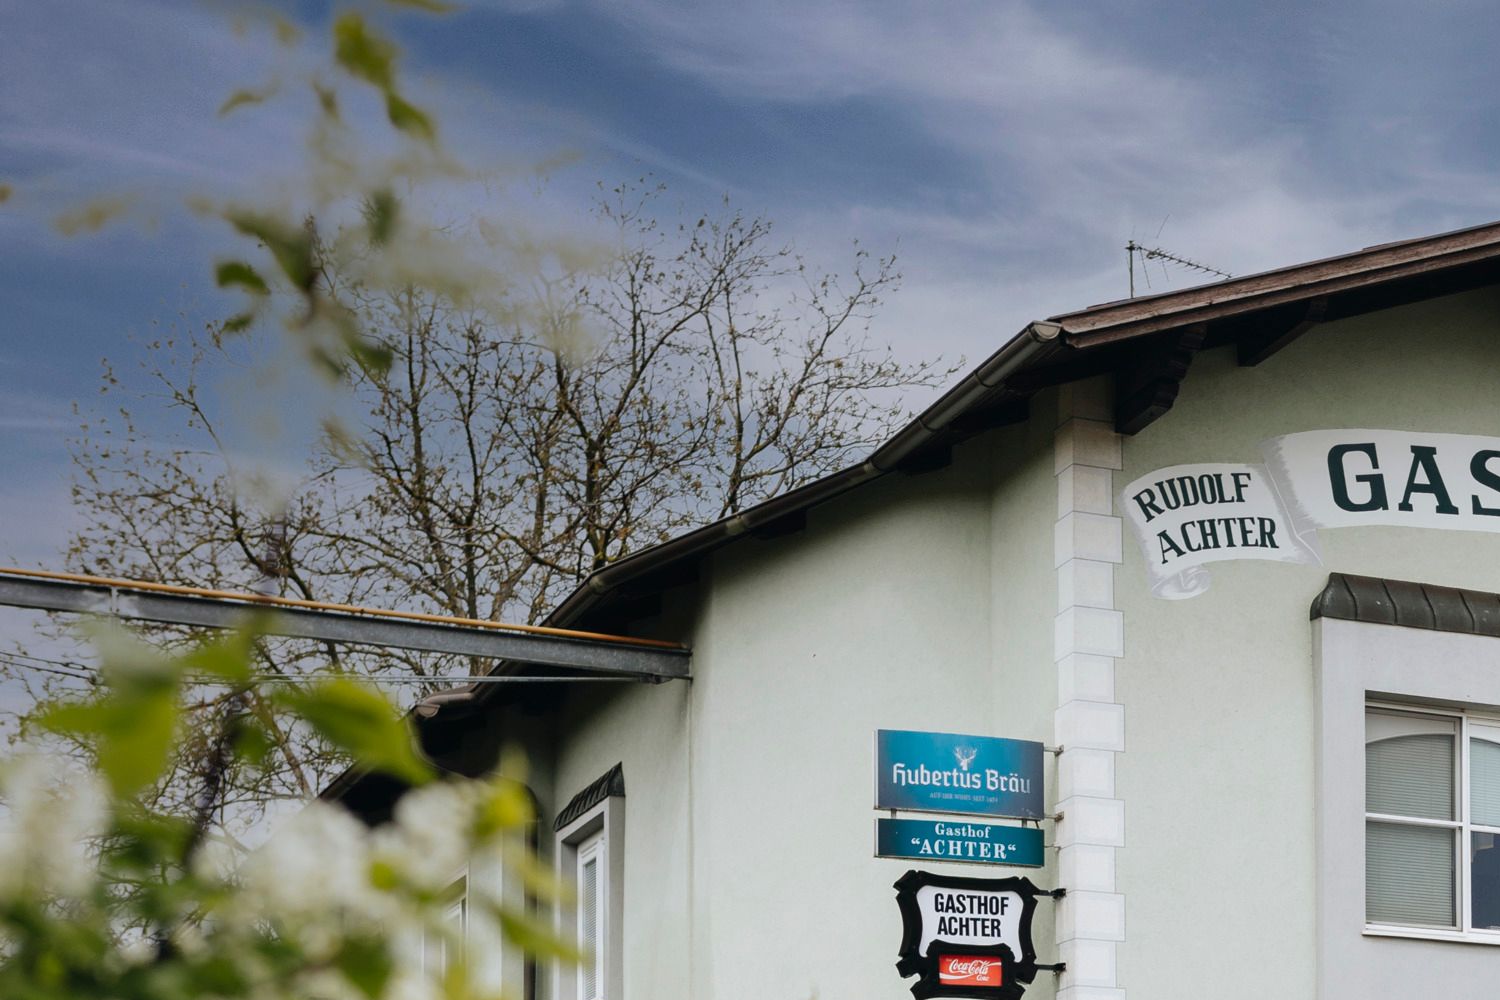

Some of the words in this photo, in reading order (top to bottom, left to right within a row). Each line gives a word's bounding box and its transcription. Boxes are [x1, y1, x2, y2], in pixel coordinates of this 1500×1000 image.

[1132, 472, 1252, 523] RUDOLF
[1156, 516, 1280, 564] ACHTER
[892, 762, 982, 790] Hubertus
[985, 768, 1031, 794] Bräu
[934, 822, 992, 839] Gasthof
[934, 893, 1010, 916] GASTHOF
[937, 916, 1002, 938] ACHTER
[949, 958, 990, 975] Coca-Cola
